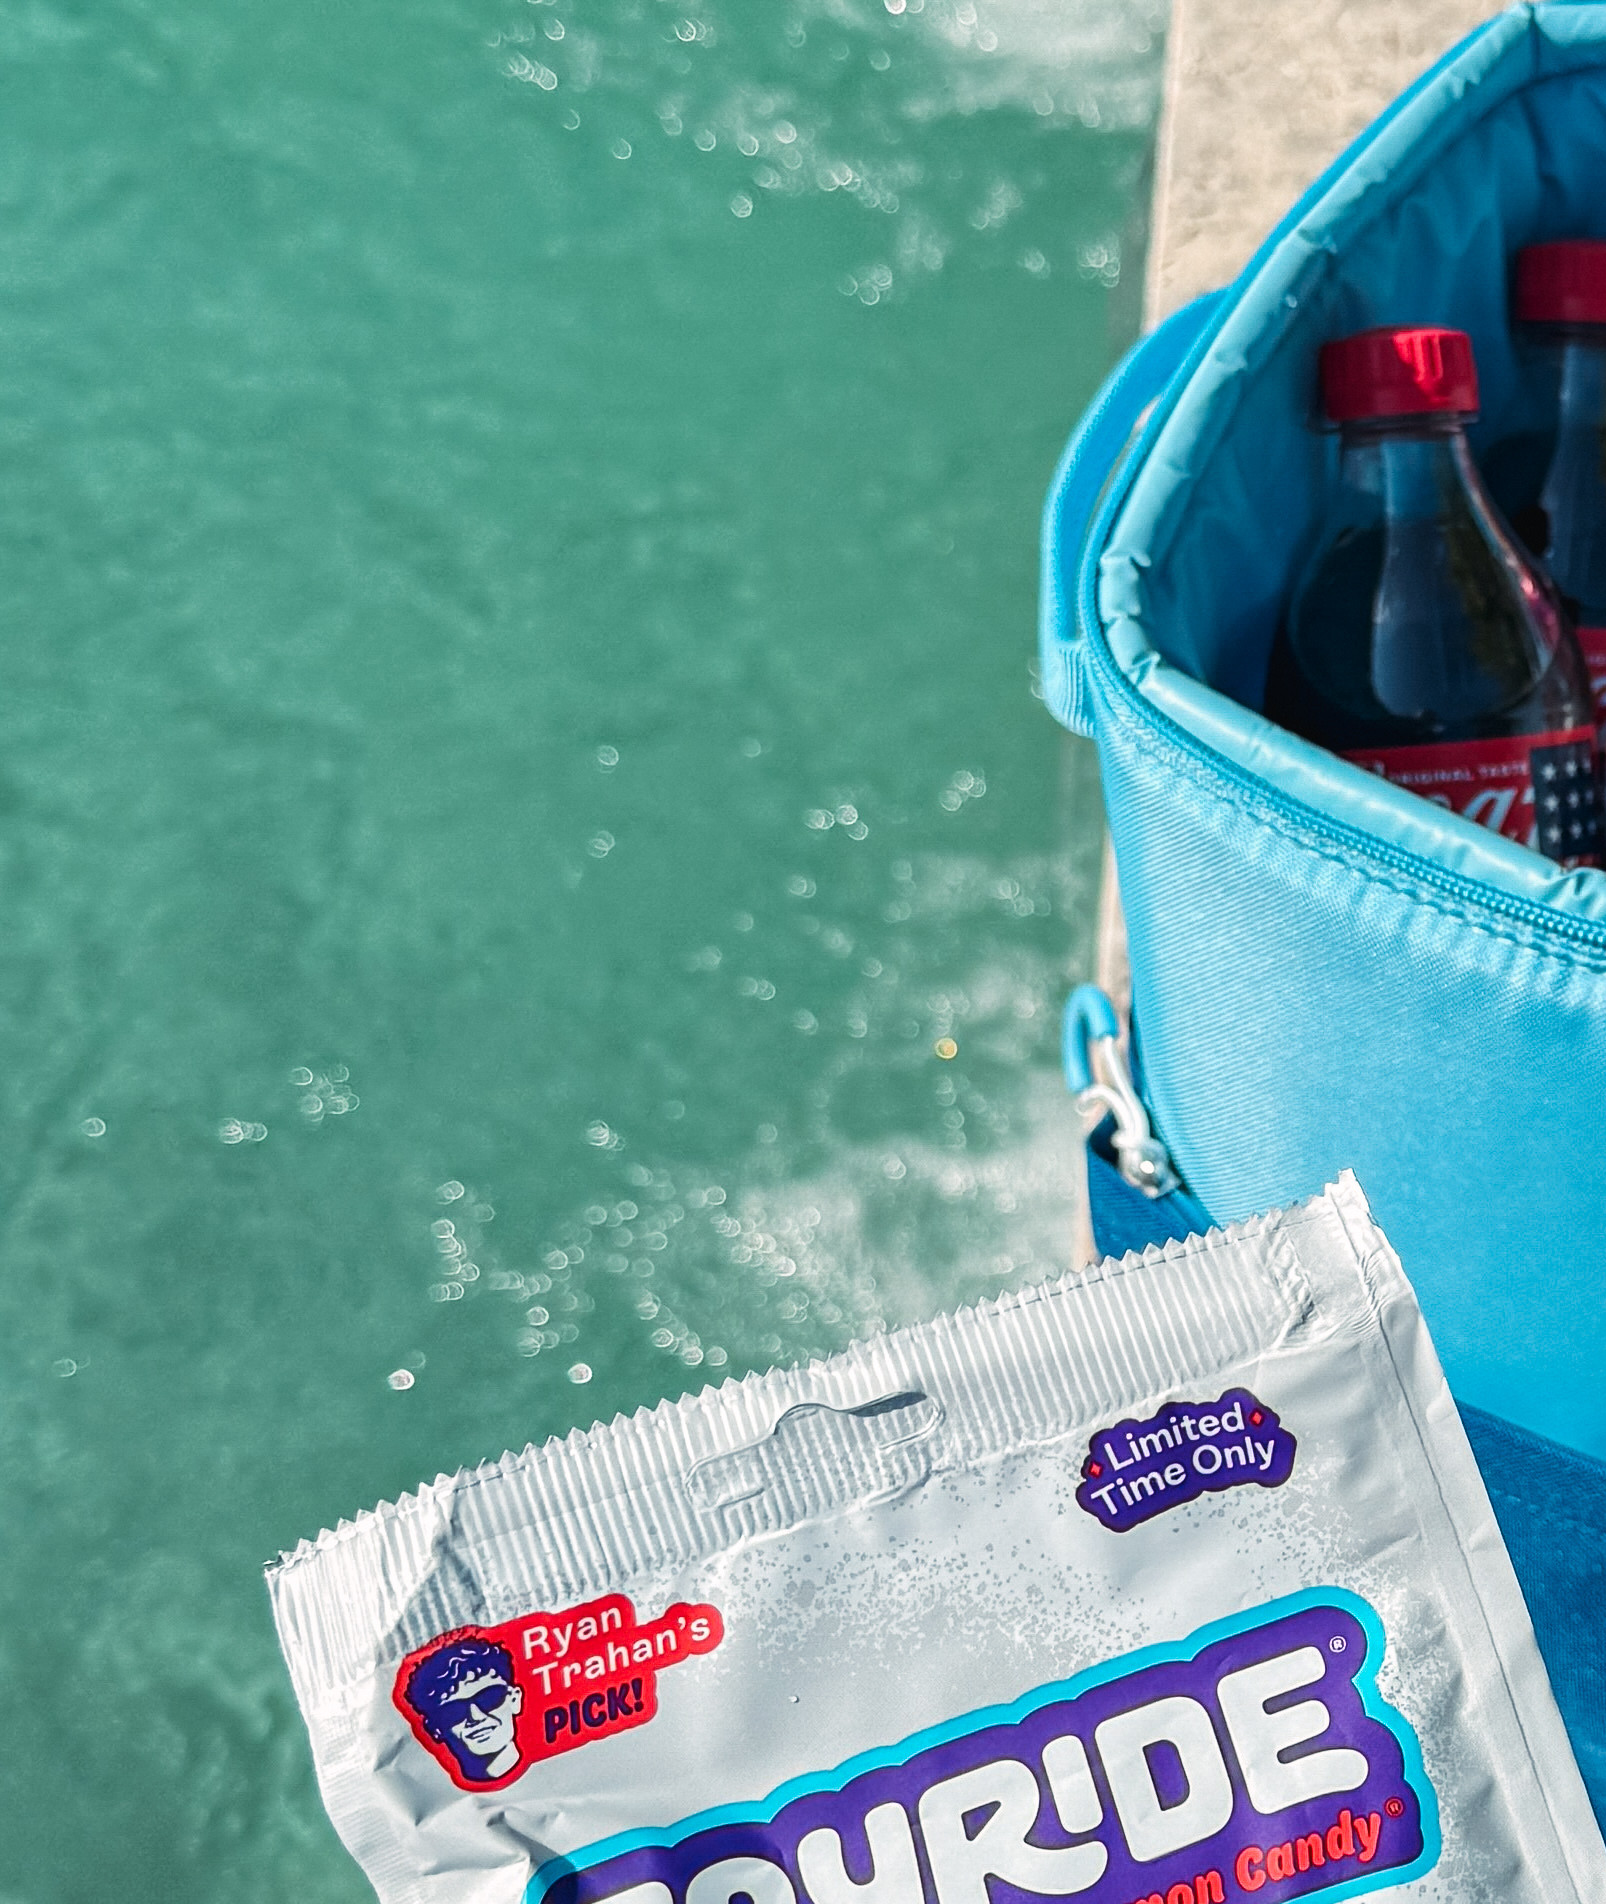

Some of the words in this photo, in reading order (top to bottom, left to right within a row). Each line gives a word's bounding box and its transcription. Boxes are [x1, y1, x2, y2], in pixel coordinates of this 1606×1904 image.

[1102, 1401, 1246, 1470] Limited
[1091, 1460, 1188, 1518] Time
[1200, 1433, 1278, 1494] Only
[520, 1606, 623, 1660] Ryan
[532, 1611, 712, 1698] Trahan's
[543, 1679, 645, 1744] PICK!
